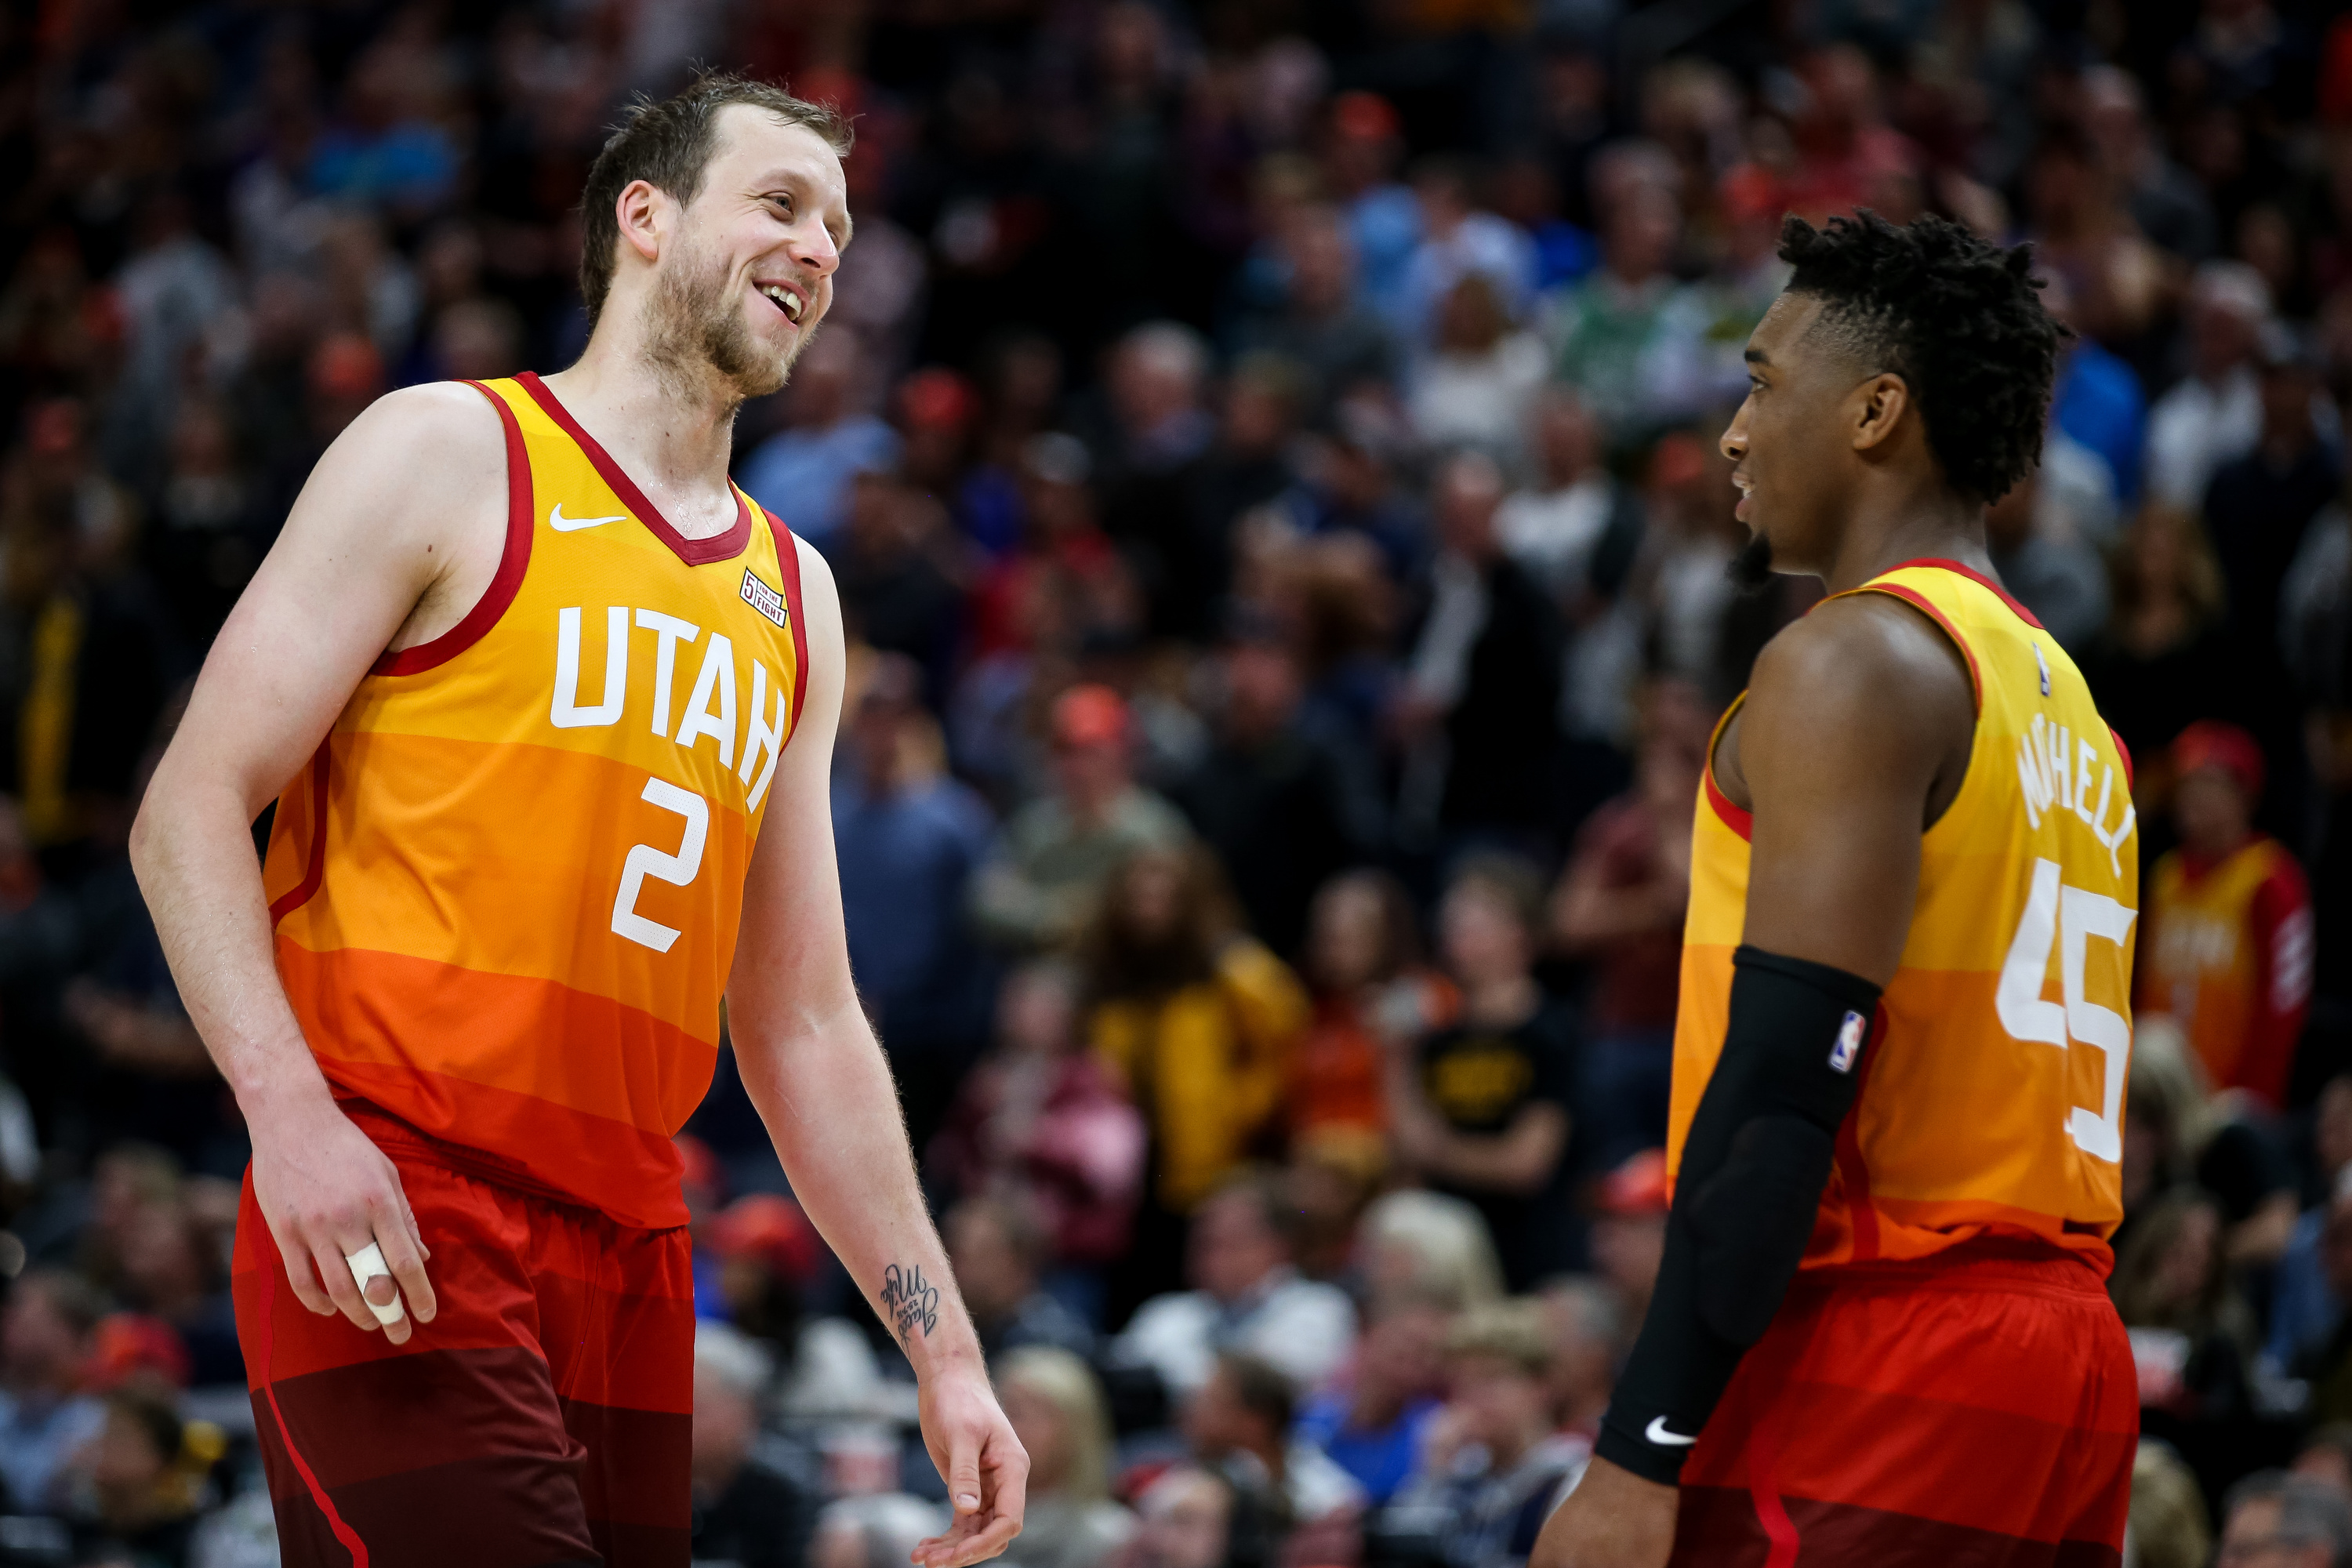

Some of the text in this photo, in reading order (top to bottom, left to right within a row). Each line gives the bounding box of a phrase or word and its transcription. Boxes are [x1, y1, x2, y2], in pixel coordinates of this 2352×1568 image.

[743, 574, 755, 600] 5
[757, 596, 782, 622] FIGHT
[759, 584, 779, 604] FOR THE
[550, 605, 786, 814] UTAH
[611, 775, 710, 954] 2
[1995, 857, 2139, 1163] 45
